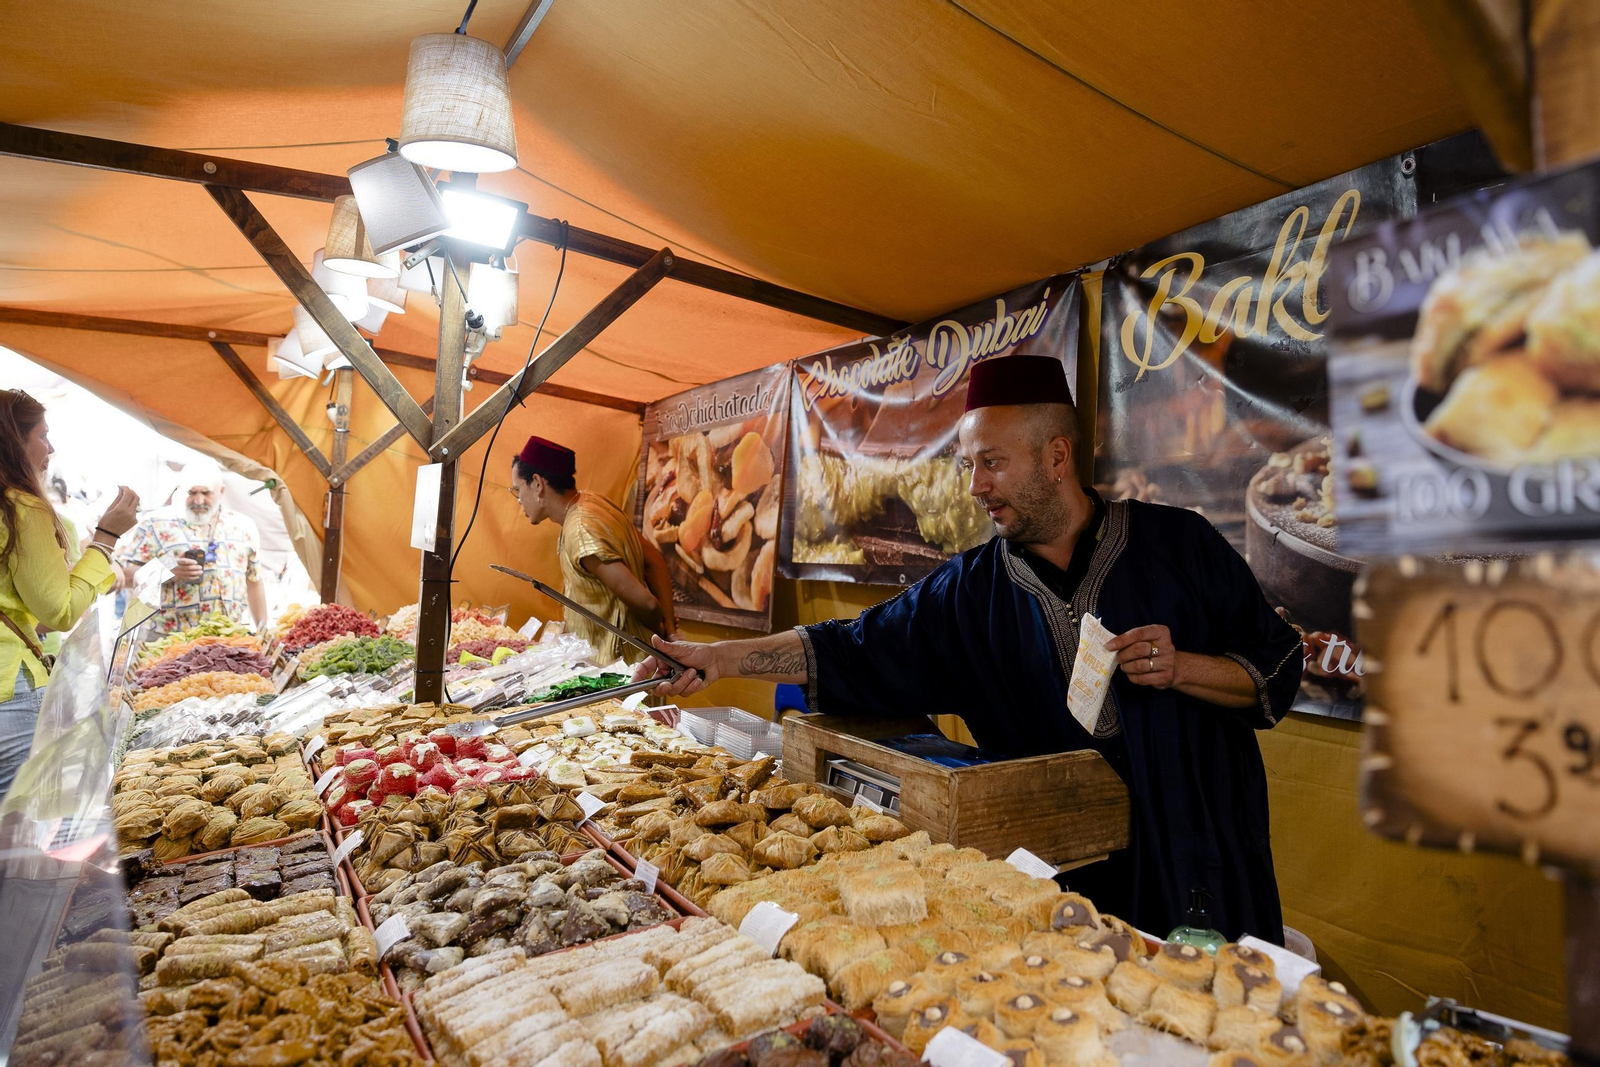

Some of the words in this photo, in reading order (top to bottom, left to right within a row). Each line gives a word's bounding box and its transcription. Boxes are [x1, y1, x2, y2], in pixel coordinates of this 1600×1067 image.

[1120, 188, 1362, 384] Bakl
[1347, 205, 1558, 313] BAKL
[801, 332, 920, 413] Chocolate
[926, 286, 1051, 397] Dubai
